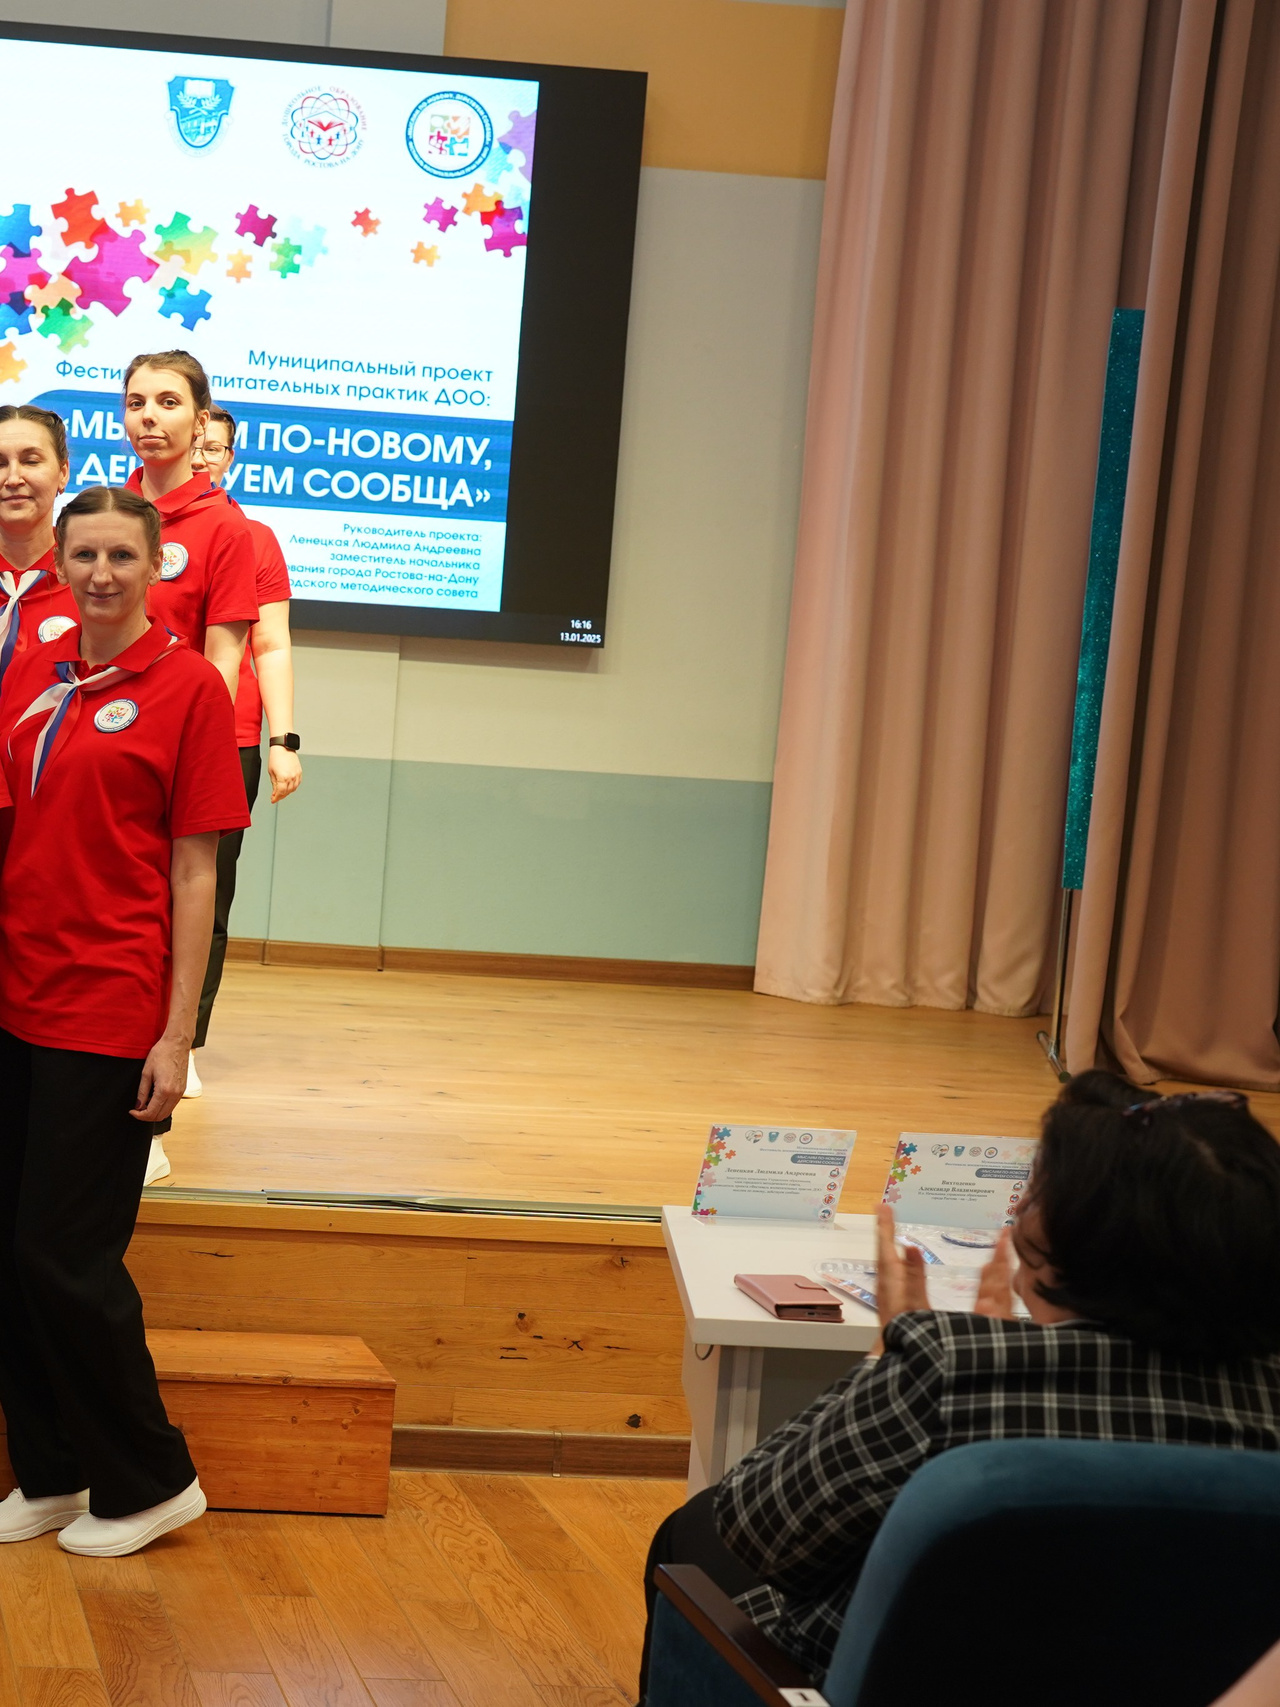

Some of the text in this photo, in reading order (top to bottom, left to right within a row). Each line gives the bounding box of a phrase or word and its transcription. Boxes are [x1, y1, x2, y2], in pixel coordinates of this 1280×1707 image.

[248, 350, 493, 382] Муниципальный проект
[346, 385, 428, 402] практик
[434, 388, 491, 407] ДОО:
[258, 422, 492, 471] ПО-НОВОМУ,
[302, 468, 491, 510] СООБЩА»
[343, 523, 482, 542] Руководитель проекта:
[289, 534, 481, 556] Ленецкая Людмила Андреевна
[330, 552, 480, 570] заместитель начальника
[328, 566, 371, 578] города
[375, 568, 480, 586] Ростова-на-Дону
[340, 581, 433, 595] методического
[436, 588, 479, 598] совета
[571, 619, 592, 630] 16:16
[560, 632, 601, 643] 13.01.2025
[951, 1186, 995, 1194] Владимирович
[797, 1691, 811, 1702] 1
